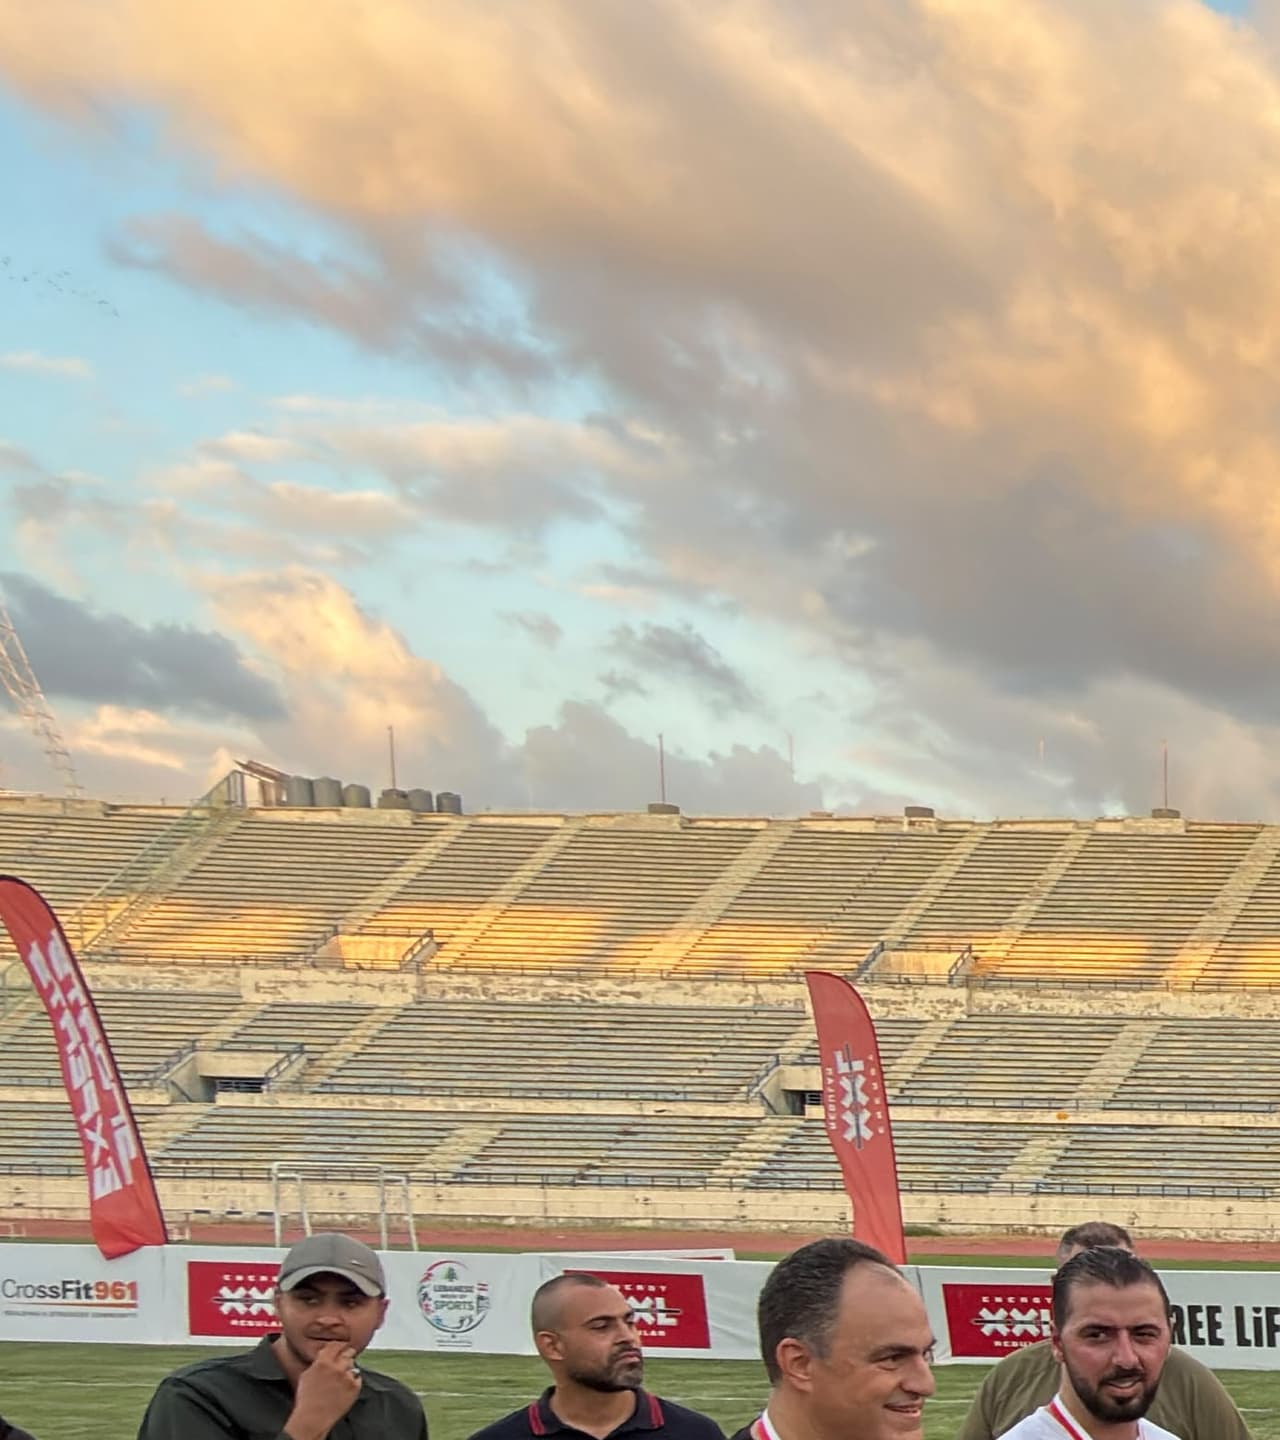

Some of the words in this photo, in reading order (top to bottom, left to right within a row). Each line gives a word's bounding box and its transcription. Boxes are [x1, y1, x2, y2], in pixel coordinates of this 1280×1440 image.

[2, 1279, 138, 1300] CrossFit961
[219, 1286, 275, 1316] XX
[626, 1296, 678, 1326] XL
[1169, 1304, 1225, 1346] REE
